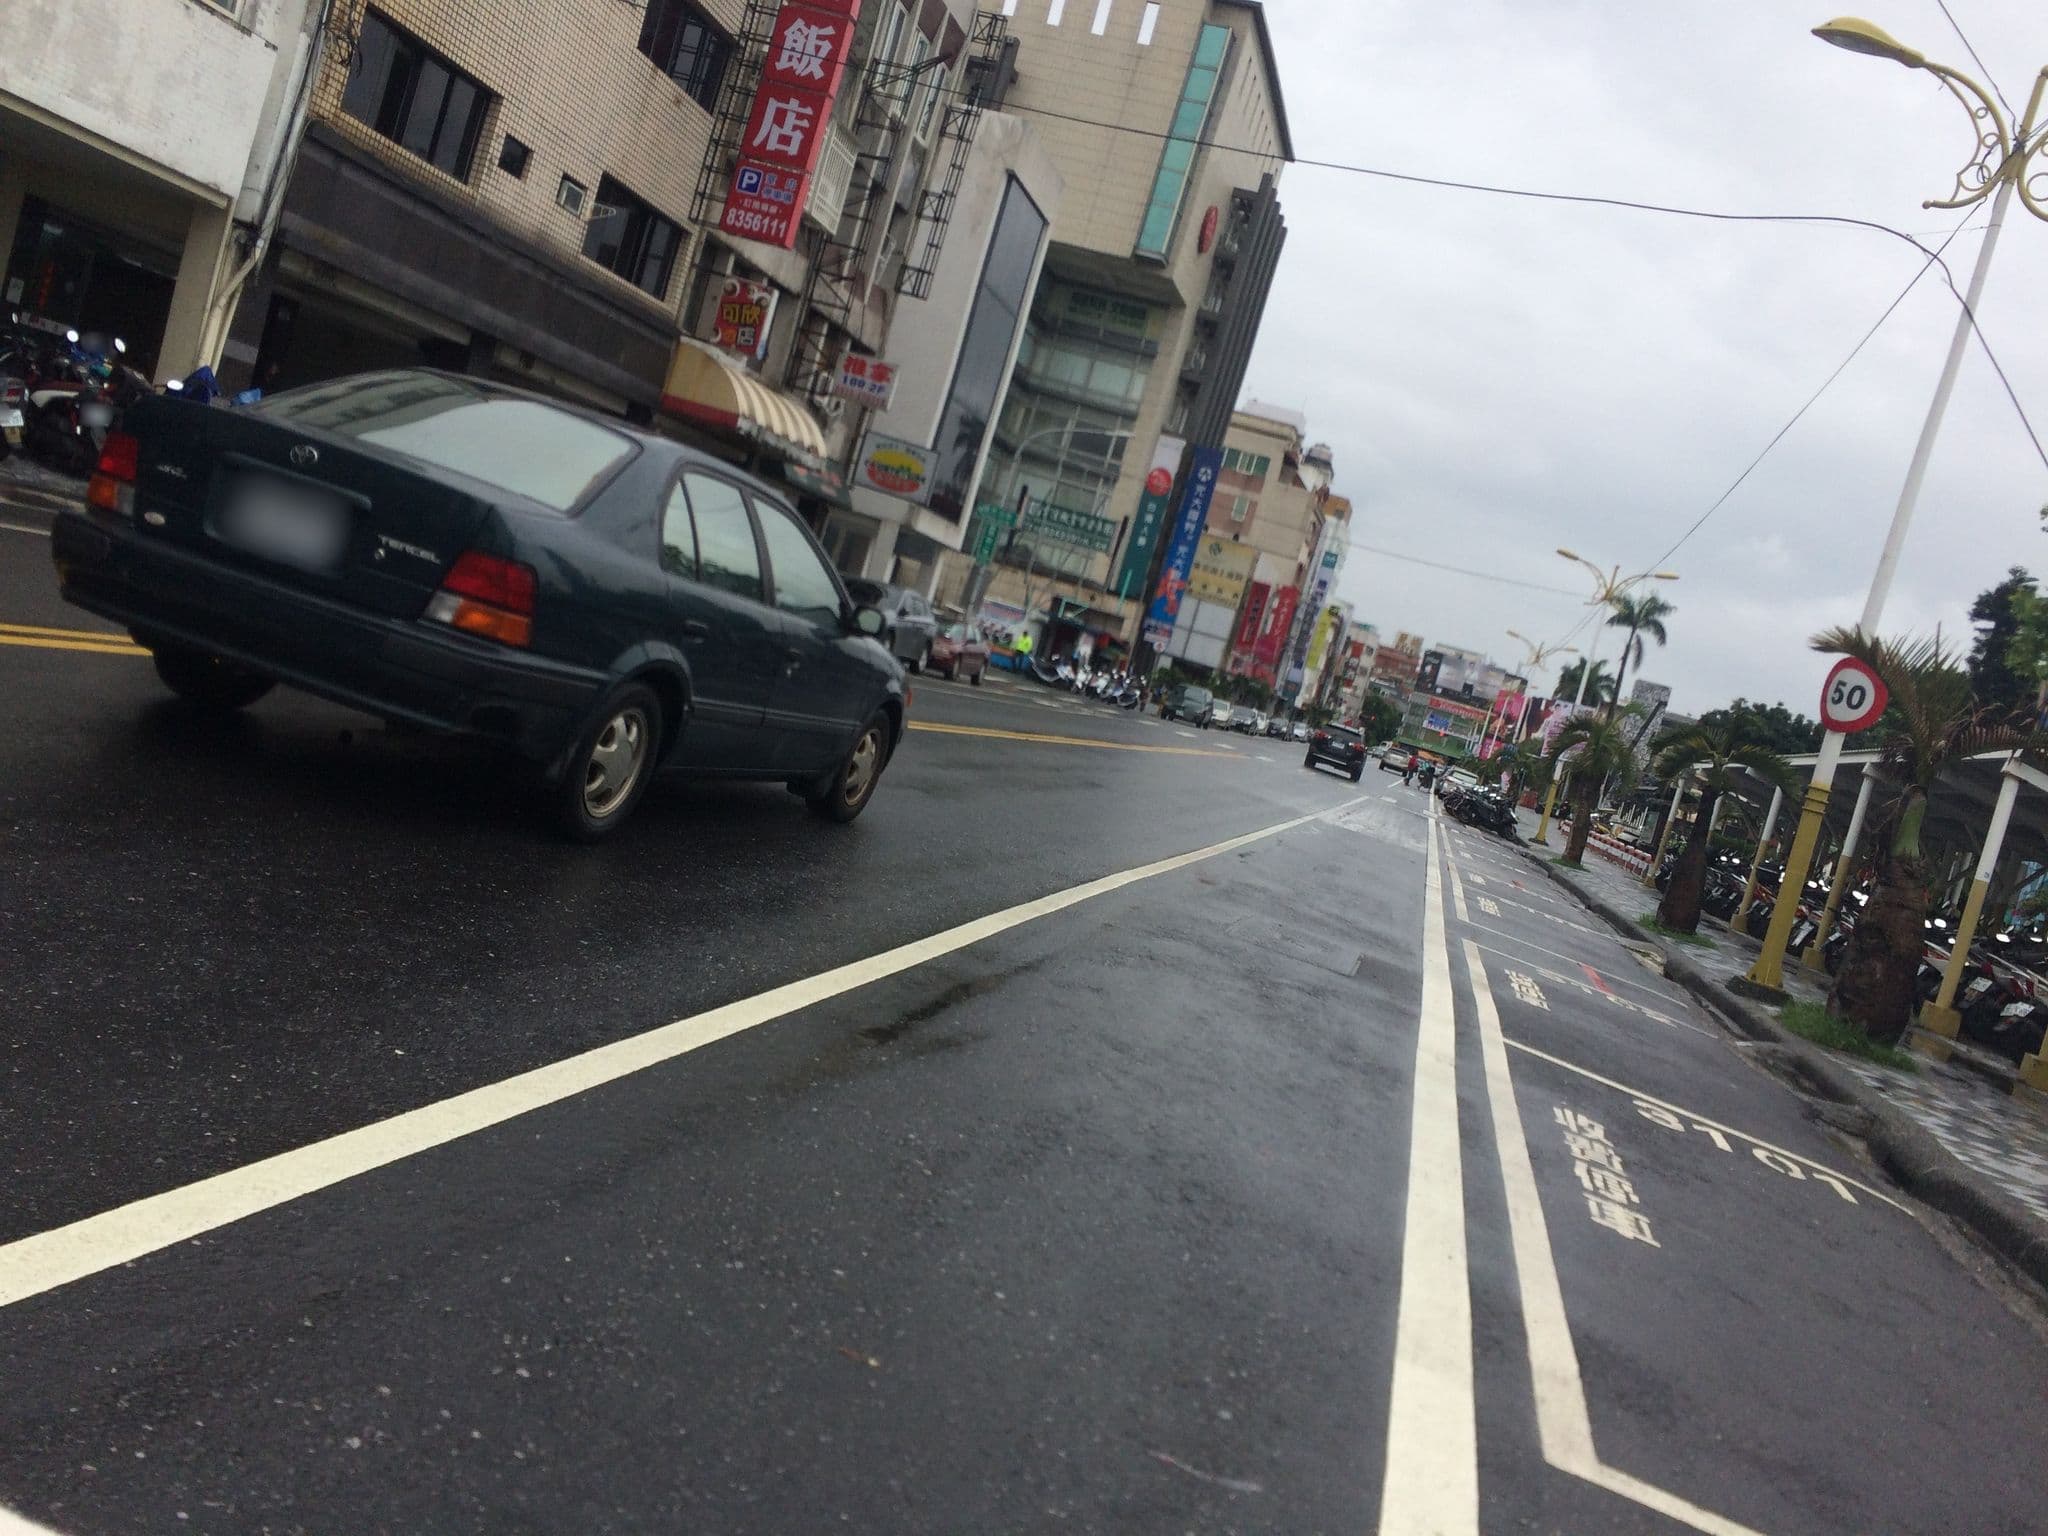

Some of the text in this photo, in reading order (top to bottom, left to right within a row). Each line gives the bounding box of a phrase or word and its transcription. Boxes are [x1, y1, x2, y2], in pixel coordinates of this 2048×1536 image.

[752, 18, 836, 156] 飯店
[741, 171, 758, 189] P
[726, 208, 787, 238] 8356111
[1832, 680, 1866, 710] 50
[1553, 1104, 1662, 1249] 收費停車
